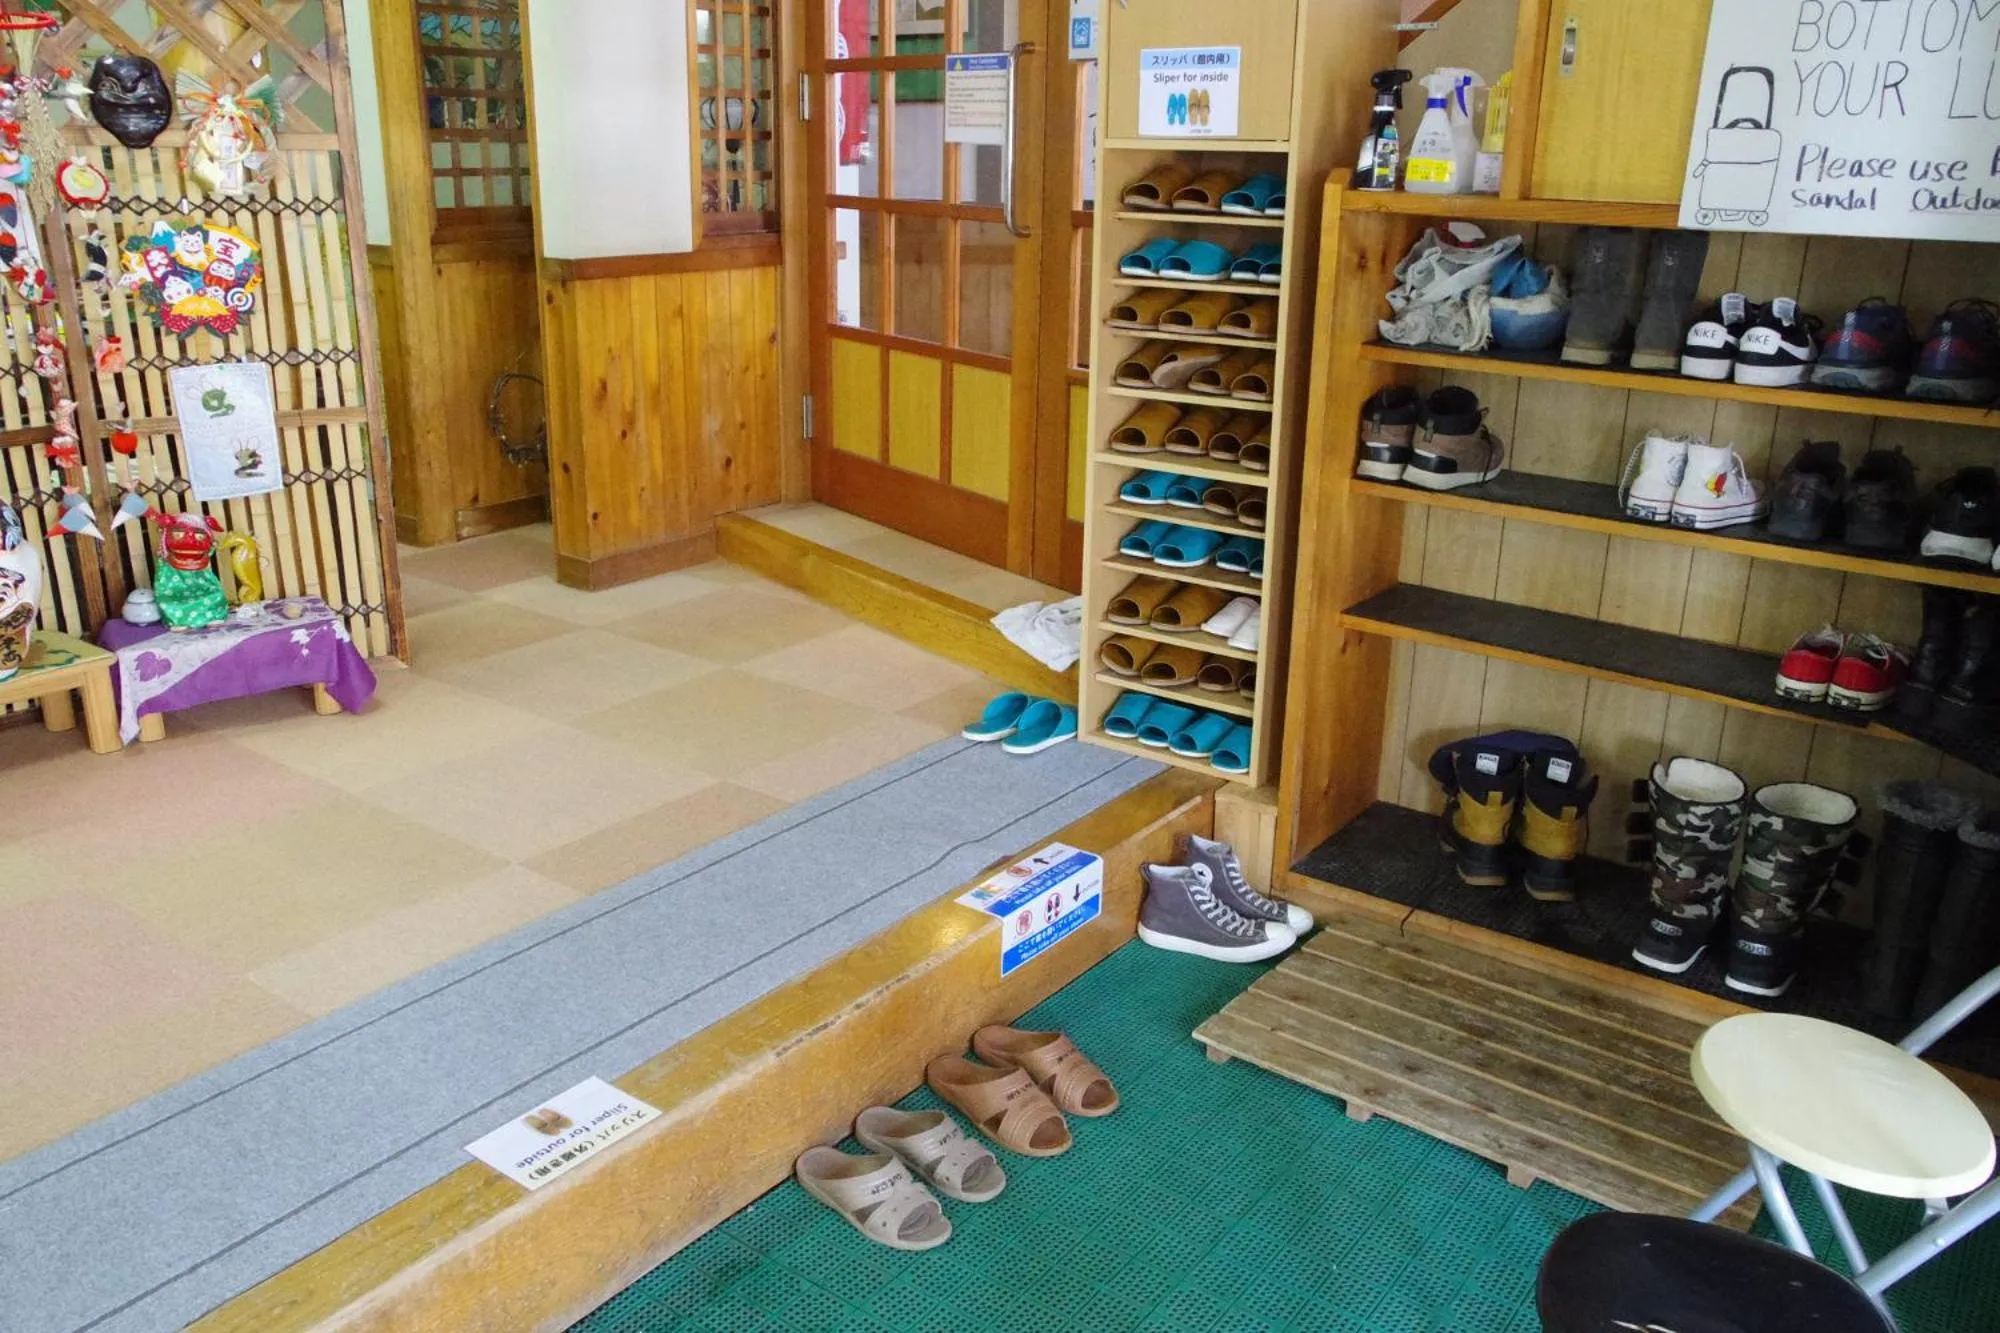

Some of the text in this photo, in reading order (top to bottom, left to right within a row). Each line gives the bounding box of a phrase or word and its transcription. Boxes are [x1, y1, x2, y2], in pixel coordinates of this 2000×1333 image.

[1153, 70, 1229, 84] Sliper for inside
[1793, 59, 1909, 119] YOUR
[1796, 143, 1897, 182] Please
[1909, 158, 1968, 182] use
